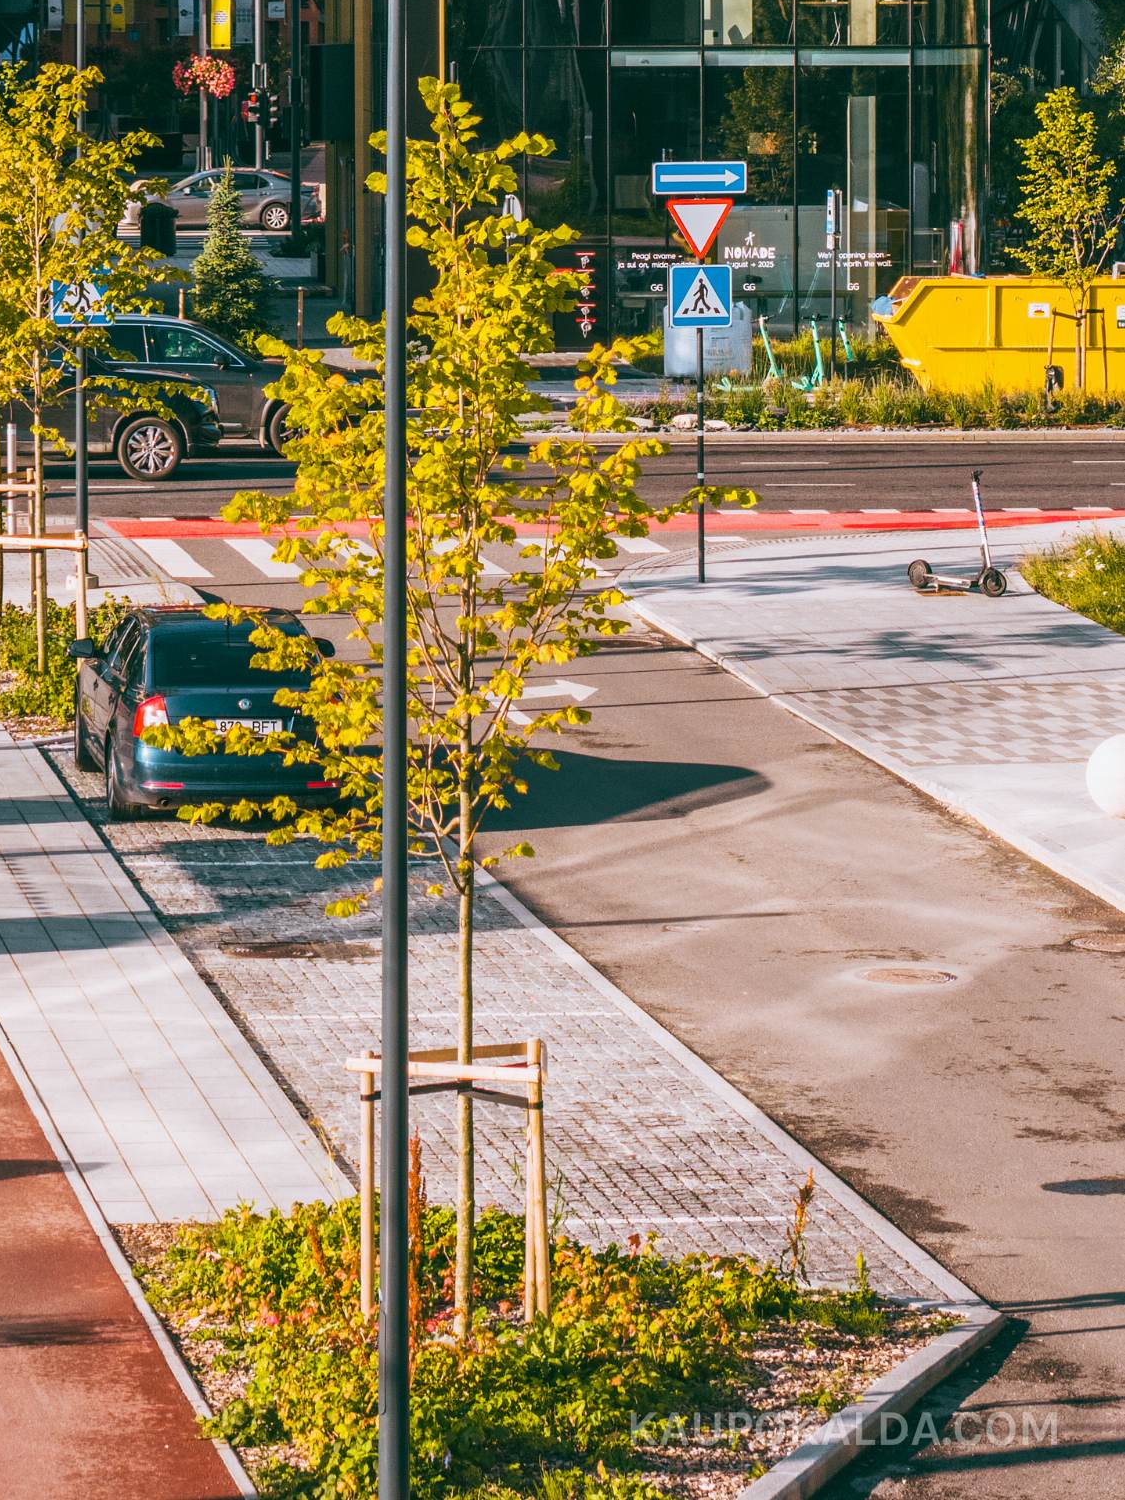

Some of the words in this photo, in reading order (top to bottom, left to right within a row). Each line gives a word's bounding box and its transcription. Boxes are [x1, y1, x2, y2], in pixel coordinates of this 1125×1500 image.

[631, 252, 651, 261] Peagi
[724, 246, 776, 259] NOMADE
[839, 252, 866, 260] opening
[617, 261, 625, 270] ja
[757, 260, 775, 268] 2025
